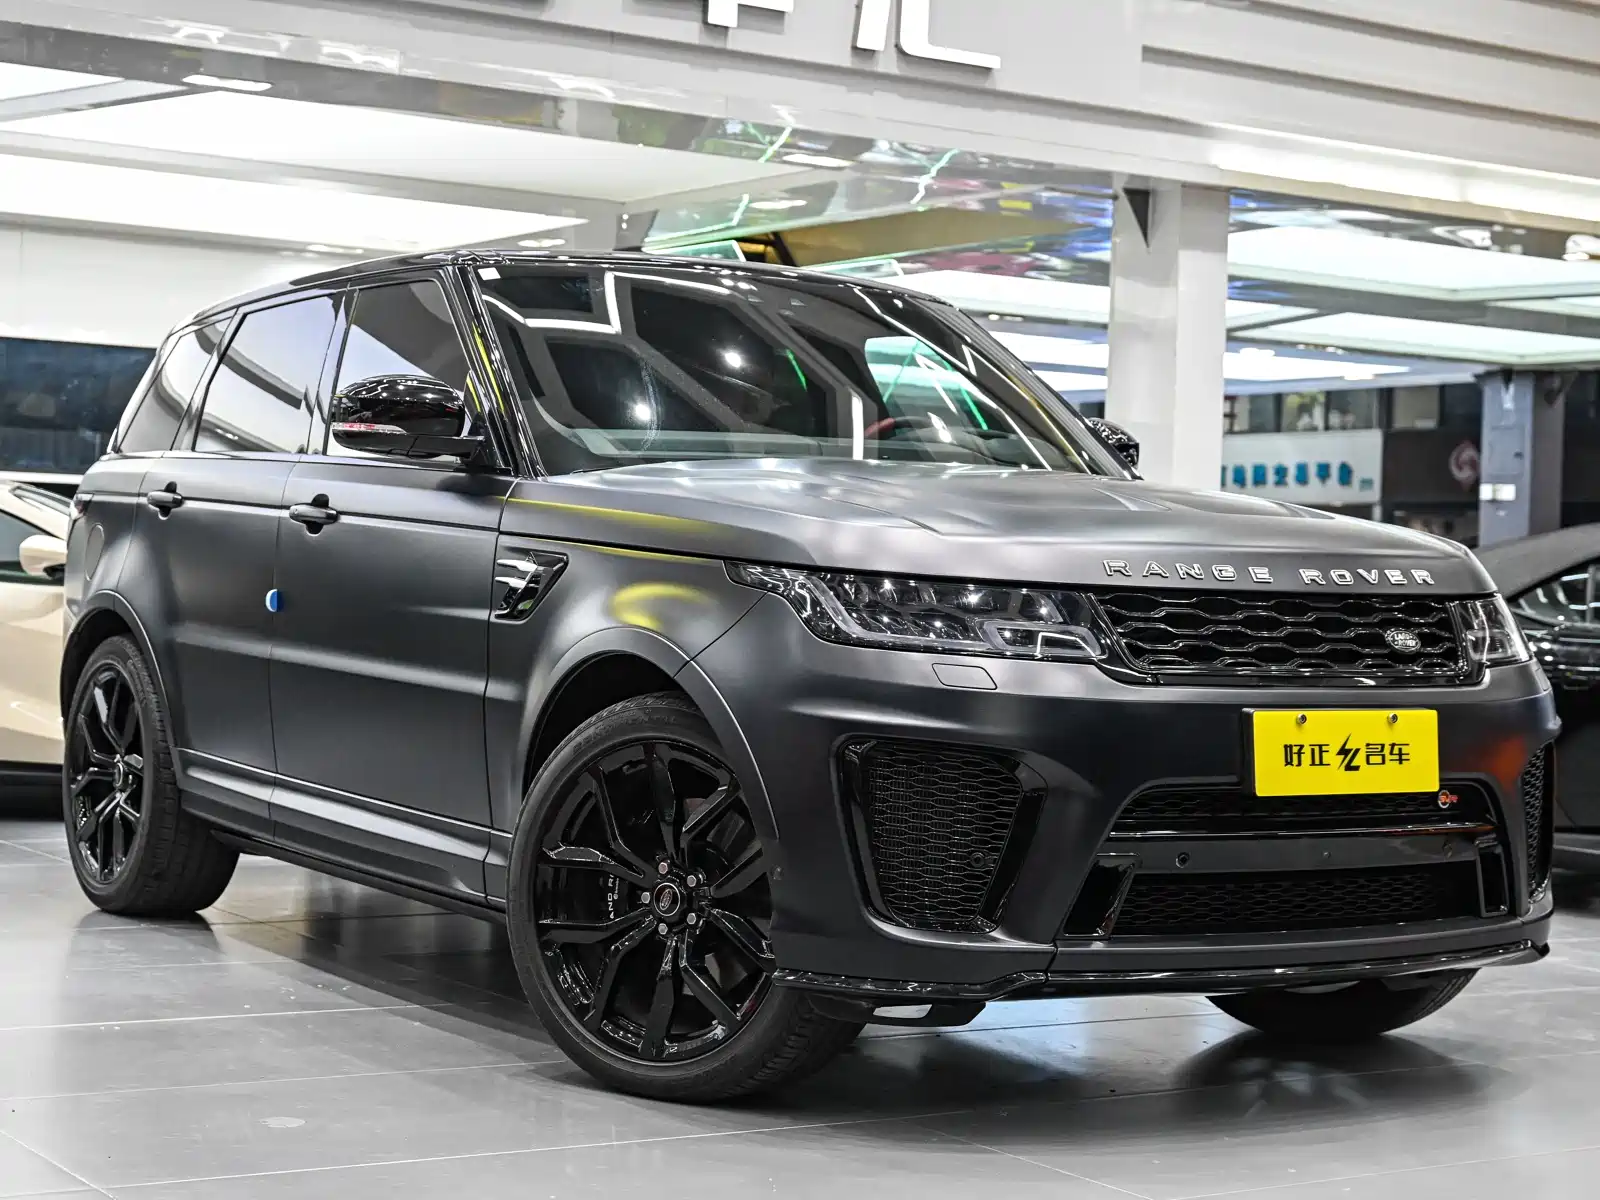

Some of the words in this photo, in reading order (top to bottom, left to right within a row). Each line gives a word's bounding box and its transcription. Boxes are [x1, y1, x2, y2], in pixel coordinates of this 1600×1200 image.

[1102, 559, 1274, 584] RANGE
[1298, 568, 1436, 586] ROVER
[1283, 743, 1332, 767] 好正
[1364, 742, 1411, 766] 名车
